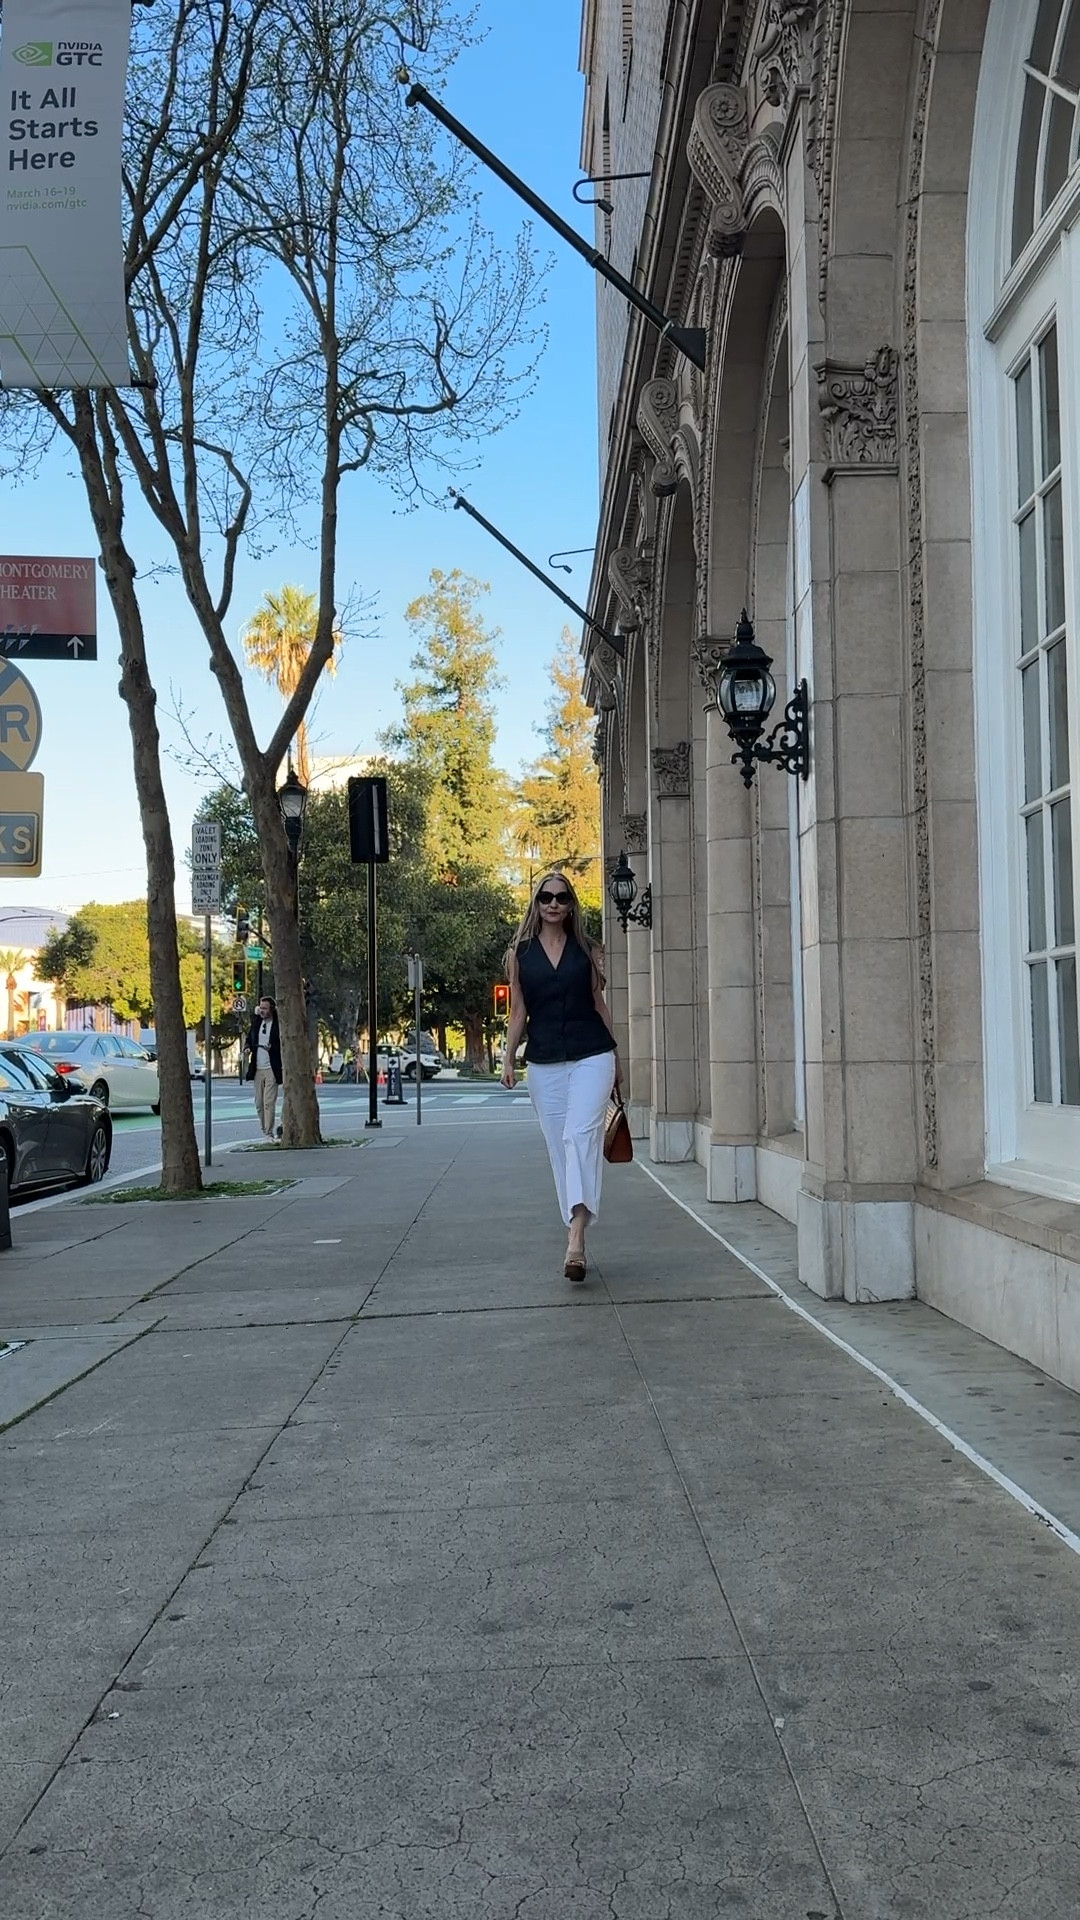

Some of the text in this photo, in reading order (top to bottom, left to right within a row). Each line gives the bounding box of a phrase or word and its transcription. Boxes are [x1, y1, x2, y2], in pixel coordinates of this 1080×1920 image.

[56, 52, 103, 66] GTC
[11, 87, 76, 110] It All
[9, 117, 99, 141] Starts
[9, 149, 75, 170] Here
[7, 188, 41, 199] March
[6, 198, 87, 211] nvidia.com/gtc
[0, 562, 92, 580] ONTGOMERY
[0, 584, 57, 601] HEATER
[196, 826, 216, 835] VALET
[195, 836, 217, 844] LOADING
[195, 853, 217, 864] ONLY
